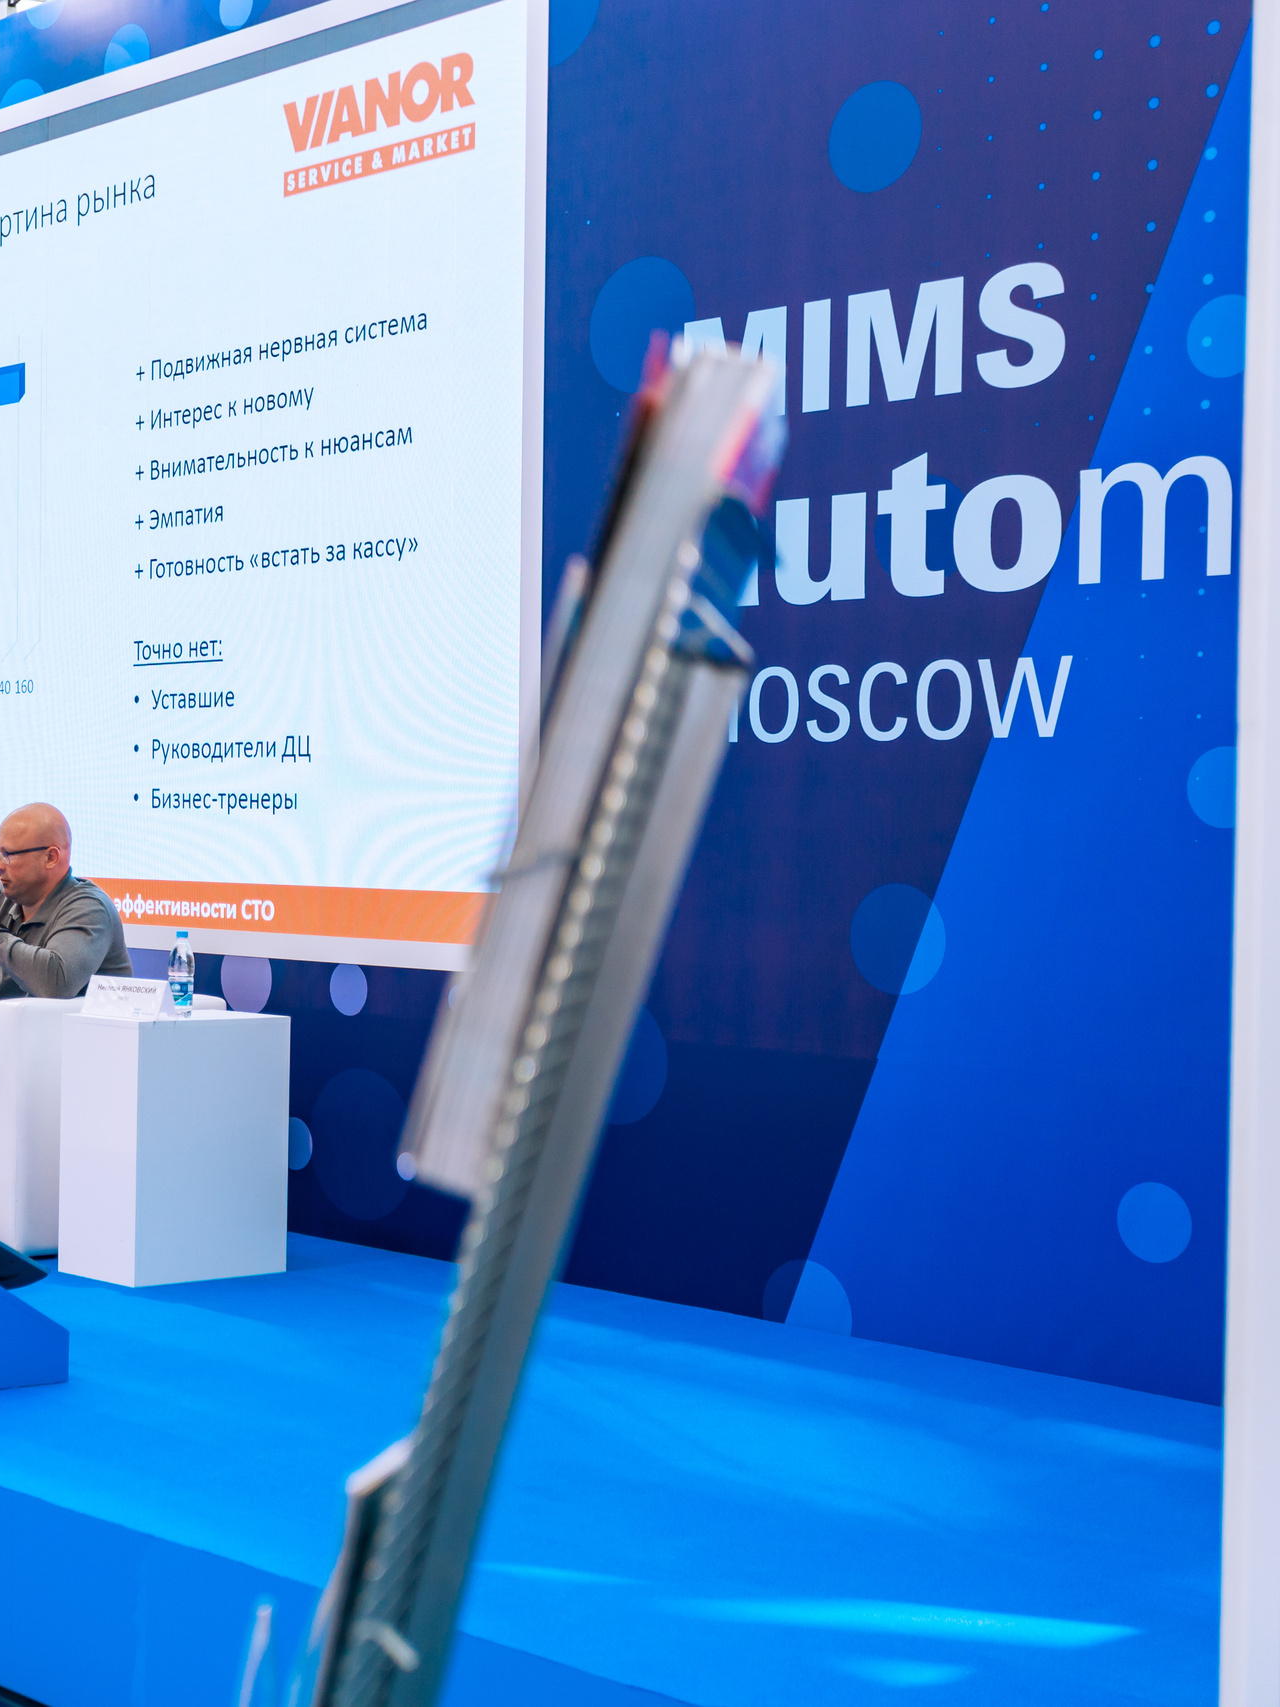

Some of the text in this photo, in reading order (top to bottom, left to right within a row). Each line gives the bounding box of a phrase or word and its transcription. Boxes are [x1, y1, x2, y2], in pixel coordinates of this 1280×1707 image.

[283, 52, 476, 153] VIANOR
[287, 126, 472, 192] SERVICE & MARKET
[77, 174, 156, 226] рынка
[151, 346, 252, 381] Подвижная
[258, 330, 338, 361] нервная
[345, 312, 428, 343] система
[150, 402, 222, 430] Интерес
[228, 400, 237, 417] к
[243, 387, 314, 415] новому
[150, 443, 299, 480] Внимательность
[305, 441, 314, 458] к
[321, 426, 413, 456] нюансам
[149, 505, 224, 530] Эмпатия
[737, 452, 1233, 606] utom
[149, 552, 244, 579] Готовность
[250, 544, 320, 569] «встать
[325, 543, 346, 562] за
[353, 537, 419, 561] кассу»
[134, 639, 223, 662] Точно нет:
[15, 679, 34, 694] 160
[151, 689, 235, 710] Уставшие
[728, 655, 1073, 744] OSCOW
[151, 735, 311, 764] Руководители ДЦ
[151, 788, 298, 815] Бизнес-тренеры
[113, 893, 275, 921] эффективности СТО
